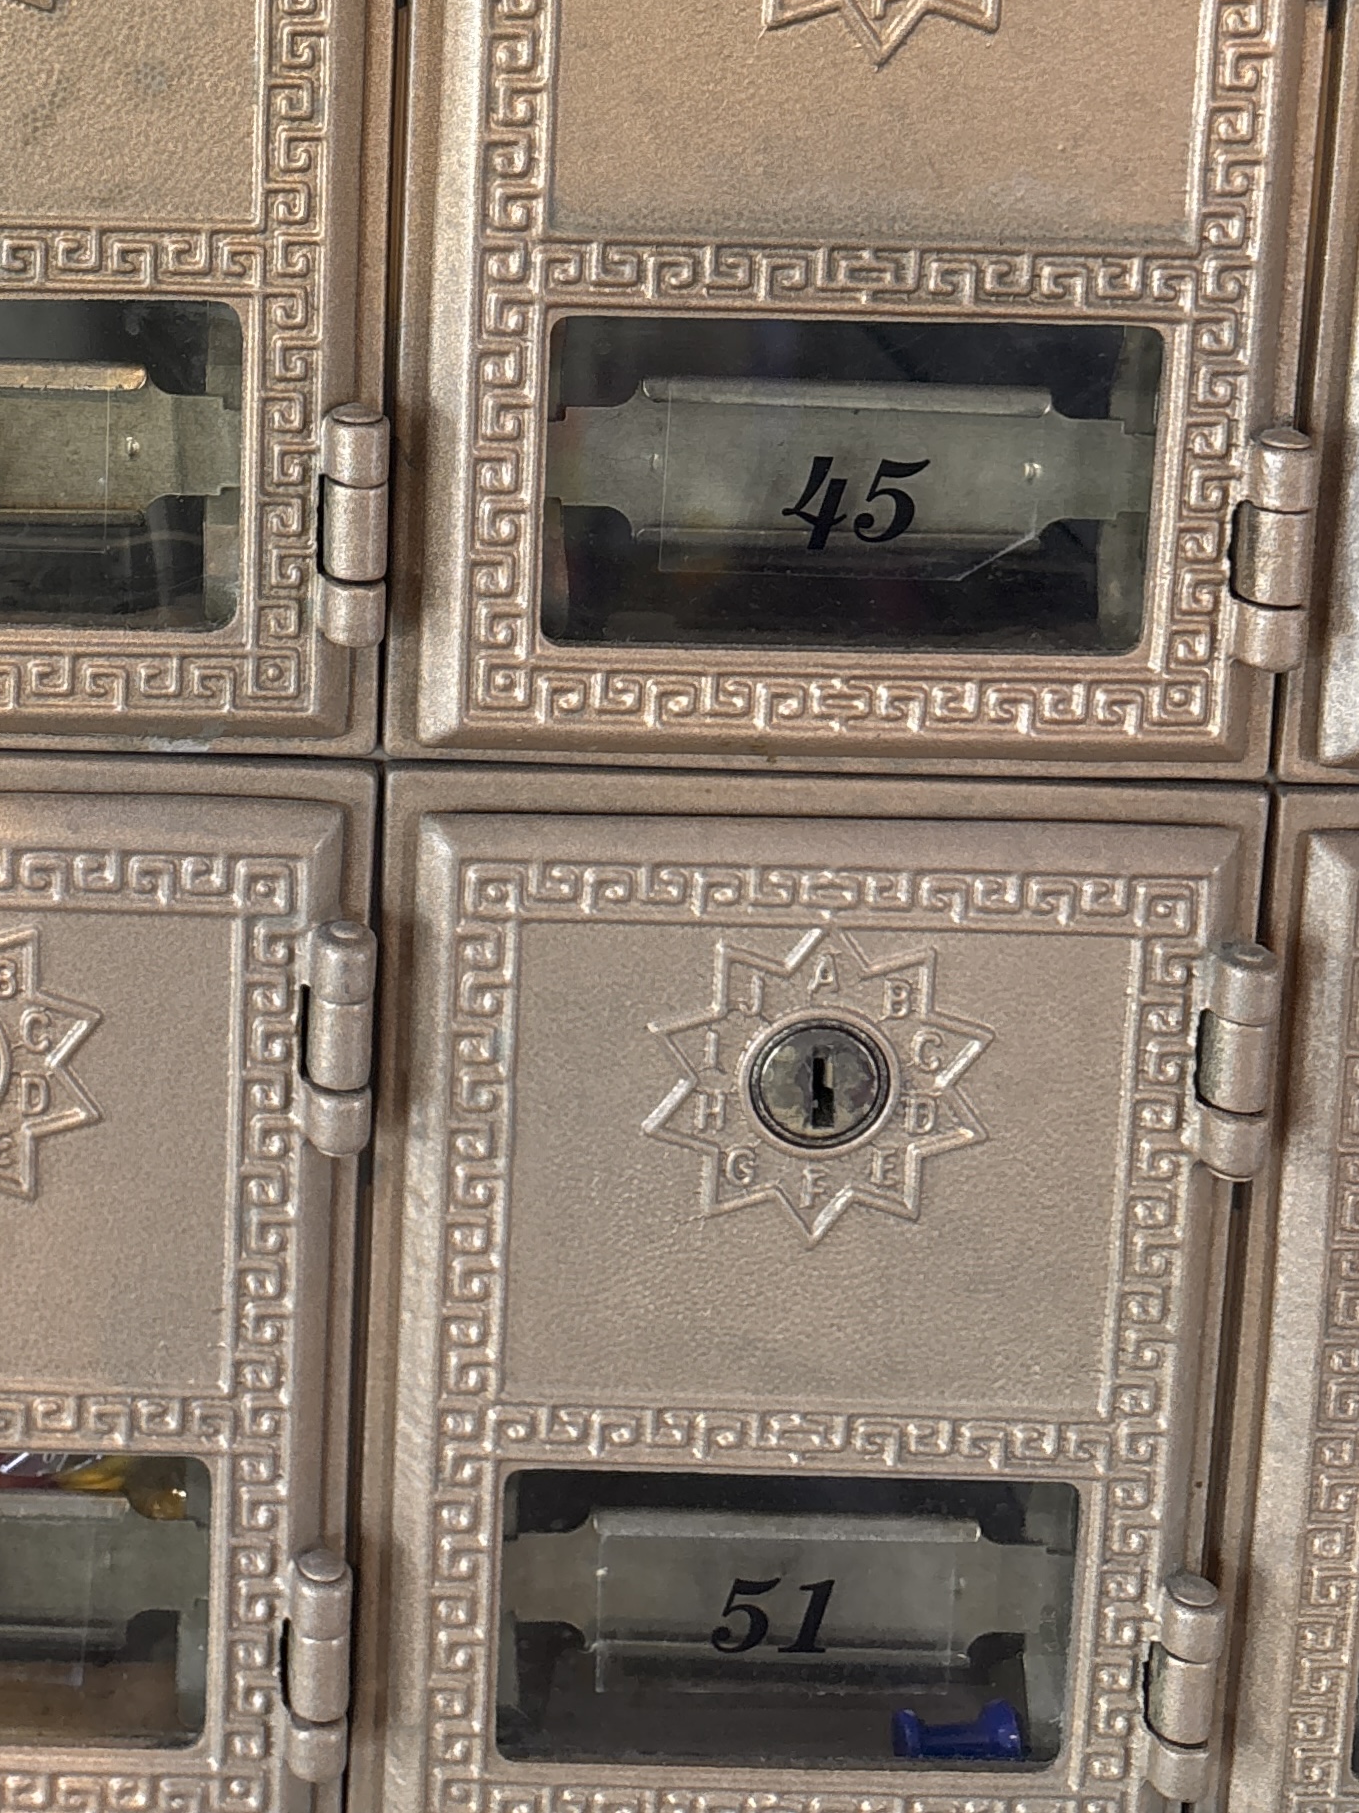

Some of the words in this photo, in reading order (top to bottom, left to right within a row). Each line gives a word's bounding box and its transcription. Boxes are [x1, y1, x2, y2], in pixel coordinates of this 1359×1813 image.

[781, 455, 931, 550] 45
[809, 953, 839, 993] A
[884, 978, 913, 1018] B
[21, 1008, 50, 1052] C
[706, 1030, 718, 1069] I
[912, 1030, 941, 1071] C
[21, 1073, 49, 1116] D
[695, 1093, 726, 1130] H
[908, 1097, 936, 1134] D
[726, 1148, 755, 1185] G
[872, 1149, 897, 1185] E
[800, 1170, 827, 1208] F
[710, 1577, 836, 1655] 51
